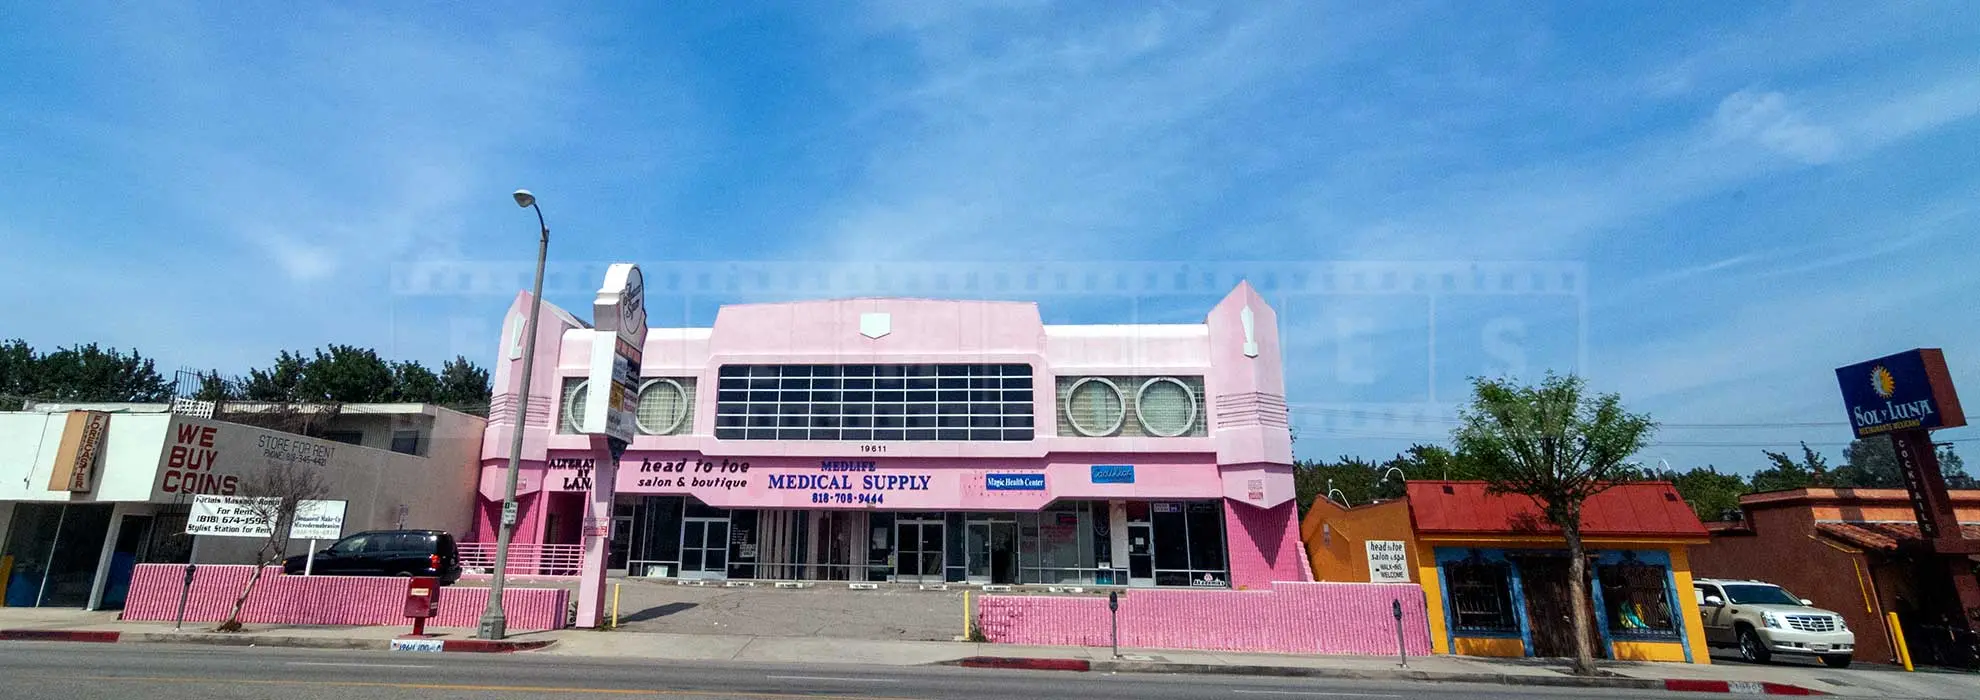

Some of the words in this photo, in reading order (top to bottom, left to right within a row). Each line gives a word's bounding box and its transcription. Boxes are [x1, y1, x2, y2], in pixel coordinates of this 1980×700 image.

[1886, 400, 1934, 421] LUNA
[178, 423, 218, 448] WE
[258, 434, 291, 451] STORE
[292, 440, 312, 454] FOR
[313, 444, 336, 459] RENT
[168, 446, 218, 471] BUY
[640, 458, 687, 473] head
[694, 460, 713, 473] to
[720, 459, 750, 473] toe
[821, 461, 877, 472] MEDLIFE
[162, 470, 238, 496] COINS
[638, 477, 672, 487] salon
[676, 477, 686, 487] &
[691, 477, 748, 490] boutique
[768, 474, 852, 490] MEDICAL
[862, 475, 931, 490] SUPPLY
[1005, 477, 1025, 486] Health
[1025, 477, 1044, 487] Center
[1898, 440, 1932, 532] COCKTAILS
[216, 507, 231, 515] For
[233, 507, 254, 516] Rent
[196, 515, 219, 524] (818)
[188, 523, 211, 533] Stylist
[214, 525, 240, 533] Station
[242, 525, 253, 534] for
[1371, 541, 1386, 551] head
[1392, 542, 1402, 551] toe
[1371, 552, 1389, 560] salon
[1394, 554, 1404, 563] spa
[1380, 571, 1404, 579] WELCOME
